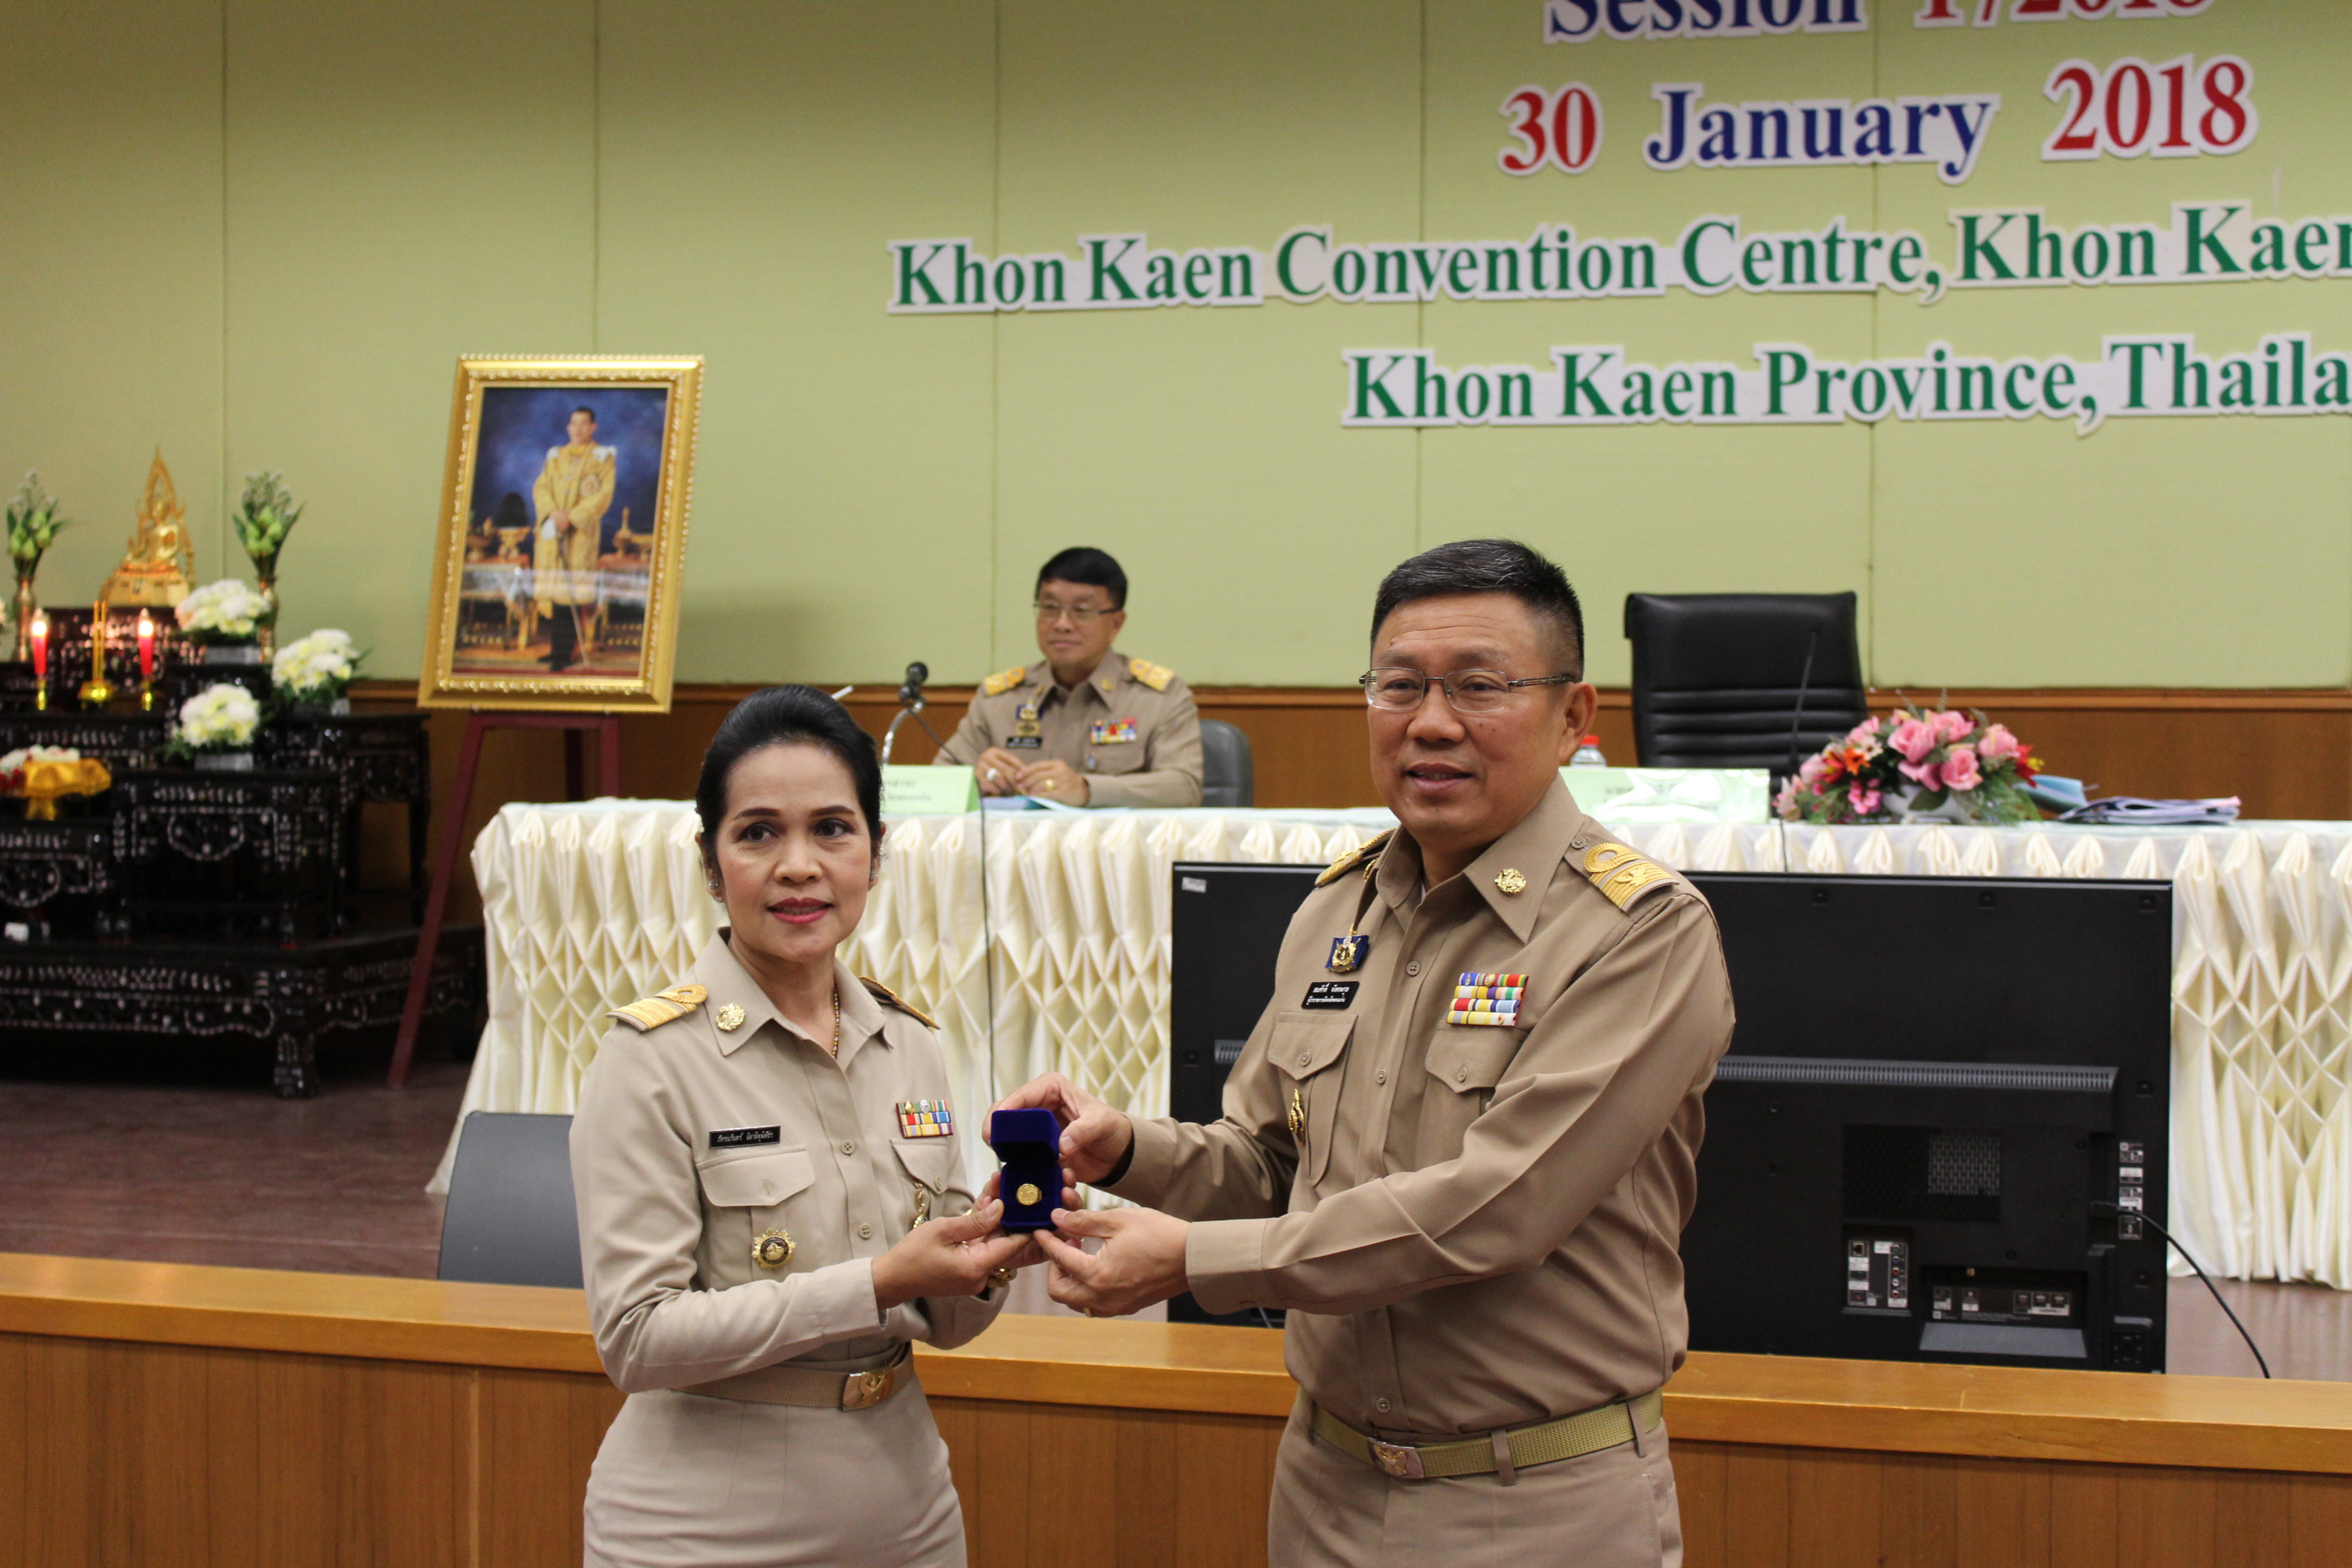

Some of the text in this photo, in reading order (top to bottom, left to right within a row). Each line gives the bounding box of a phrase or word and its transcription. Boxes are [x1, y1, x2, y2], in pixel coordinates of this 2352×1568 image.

[1501, 62, 2248, 178] 30 January 2018
[895, 243, 1066, 306] Khon
[1088, 238, 1254, 301] Kaen
[1277, 230, 1657, 297] Convention
[1683, 221, 1942, 299] Centre,
[1957, 213, 2157, 280] Khon
[1350, 355, 1534, 419] Khon
[1558, 352, 1737, 417] Kaen
[1764, 348, 2097, 427] Province,
